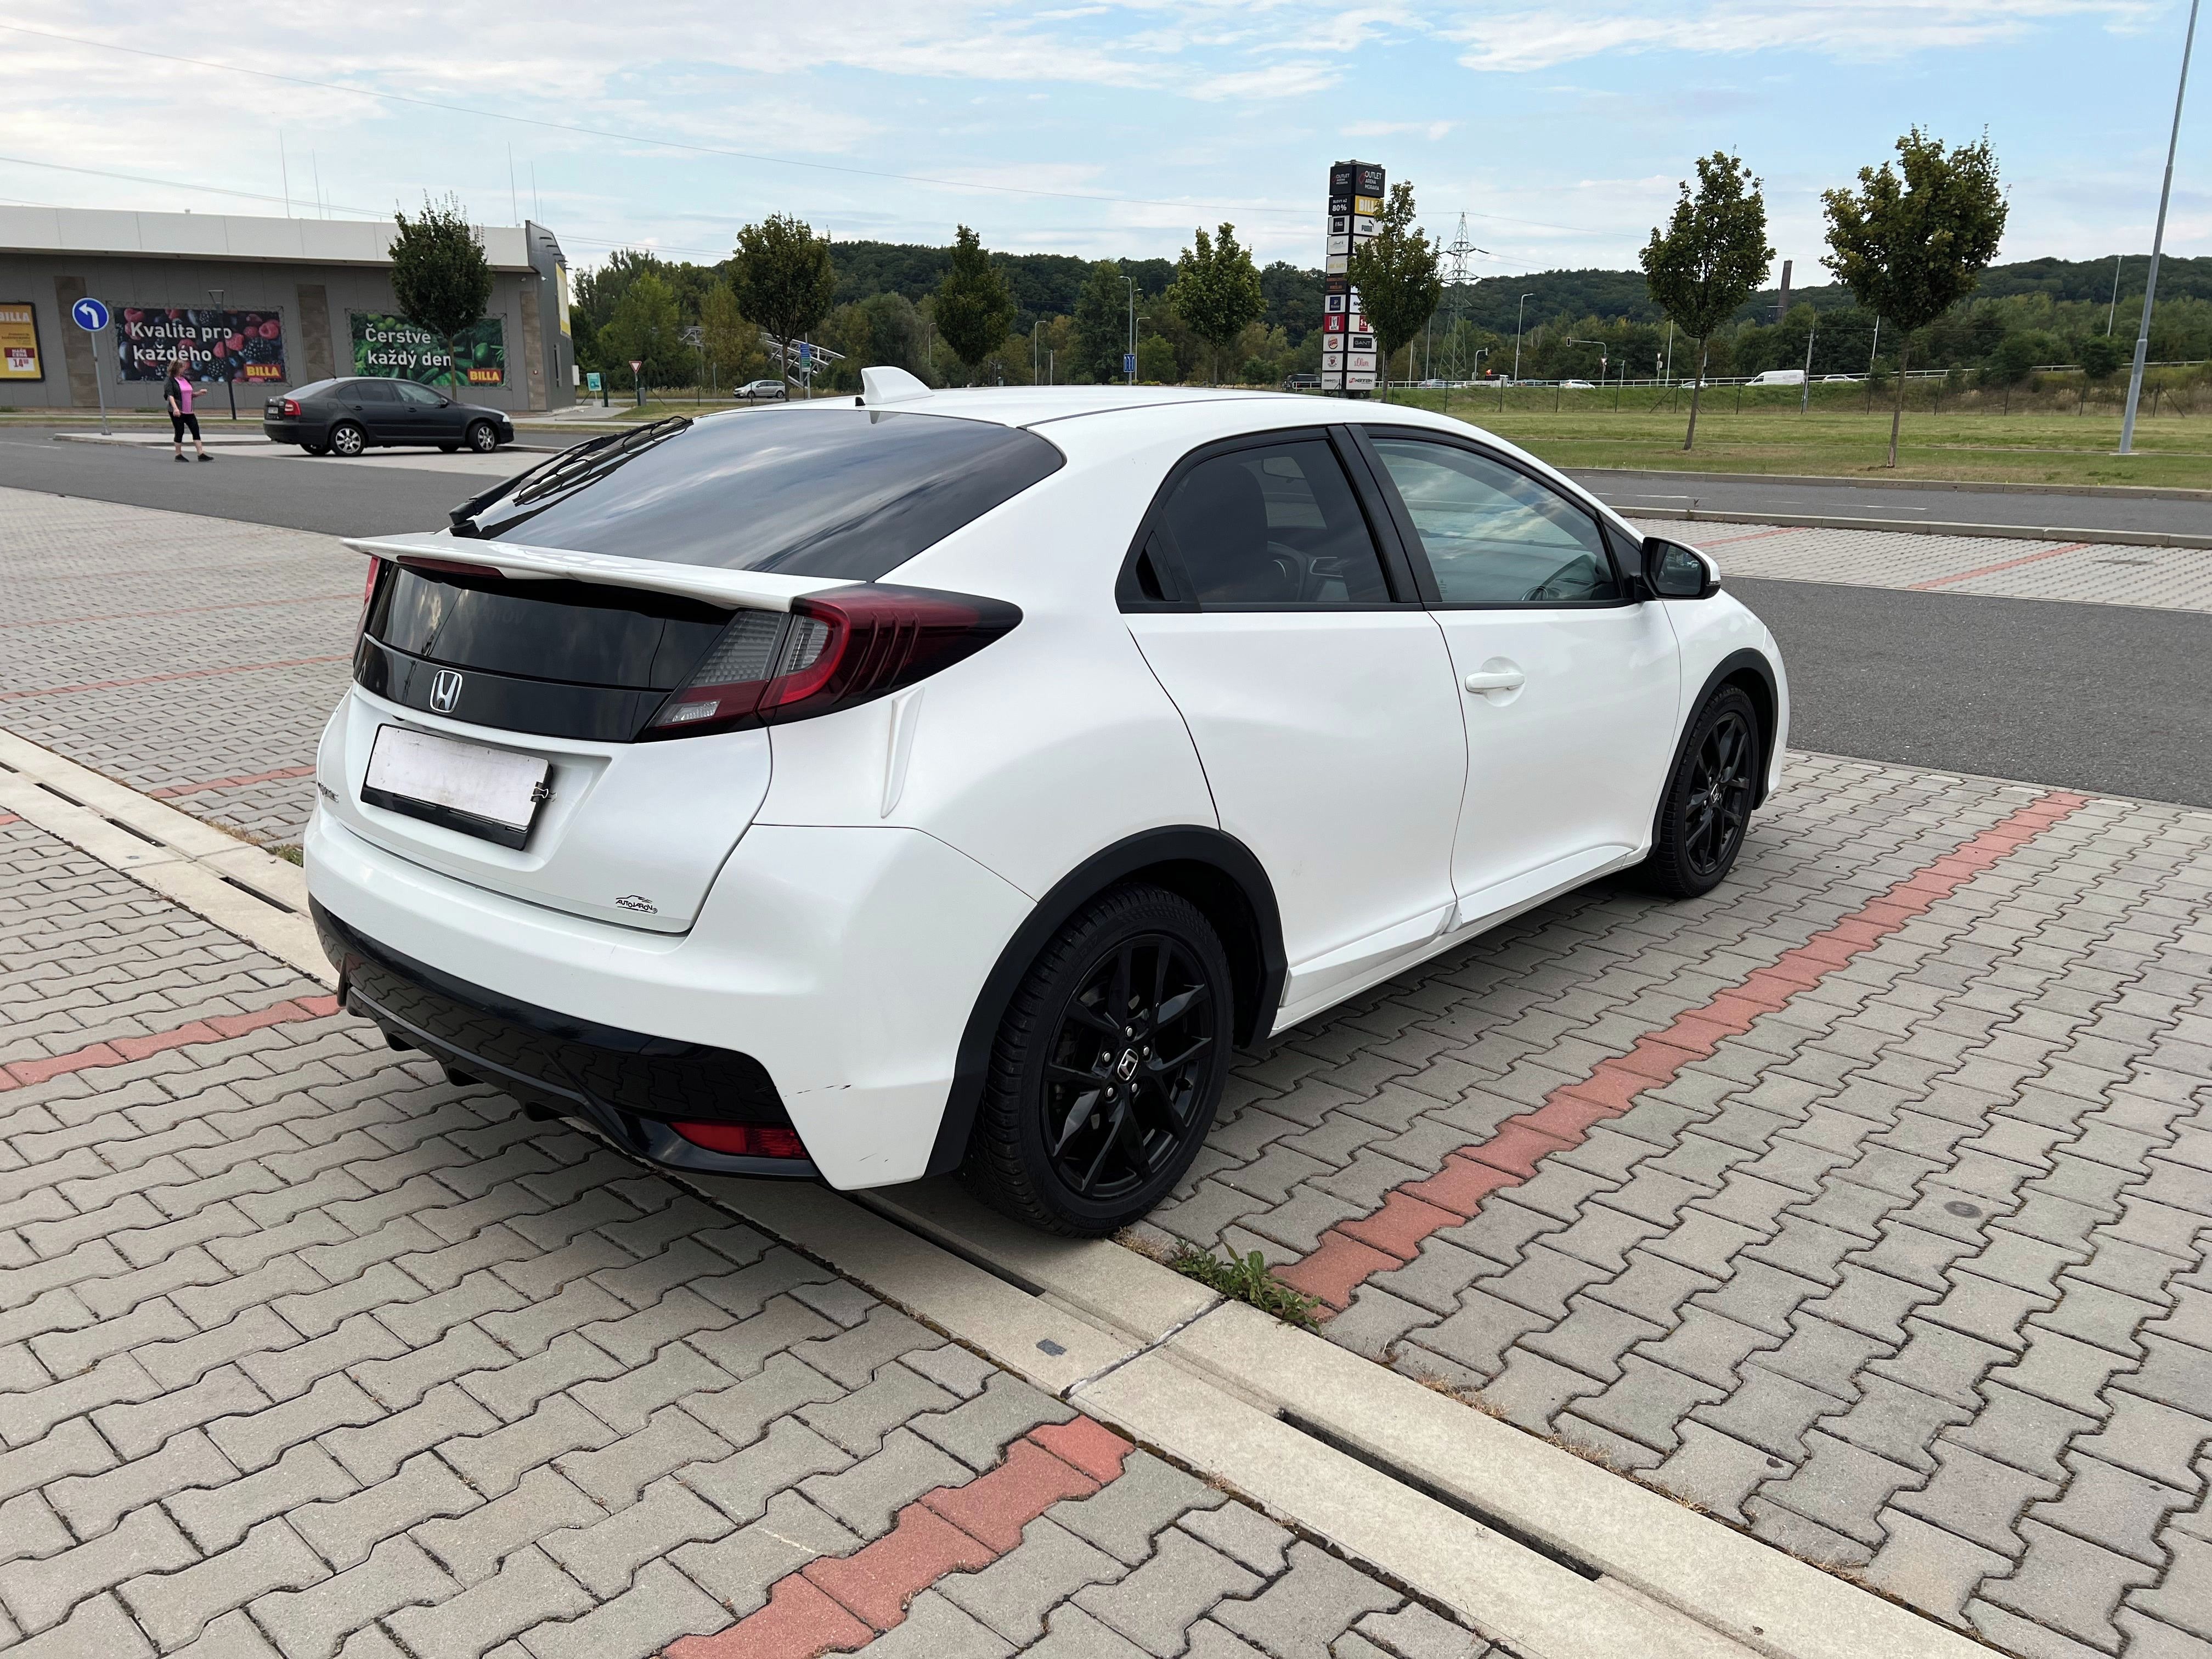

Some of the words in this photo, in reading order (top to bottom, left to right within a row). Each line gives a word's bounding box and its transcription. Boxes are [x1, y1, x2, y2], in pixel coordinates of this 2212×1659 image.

[1365, 170, 1382, 179] OUTLET
[1359, 199, 1376, 213] BILL
[131, 321, 196, 338] Kvalita
[202, 327, 232, 342] pro
[365, 323, 431, 344] Čerstvé
[133, 342, 212, 362] každého
[368, 349, 417, 369] každý
[422, 352, 452, 366] den
[247, 366, 279, 376] BILLA
[470, 371, 500, 381] BILLA
[616, 899, 653, 911] AUTOJAROV
